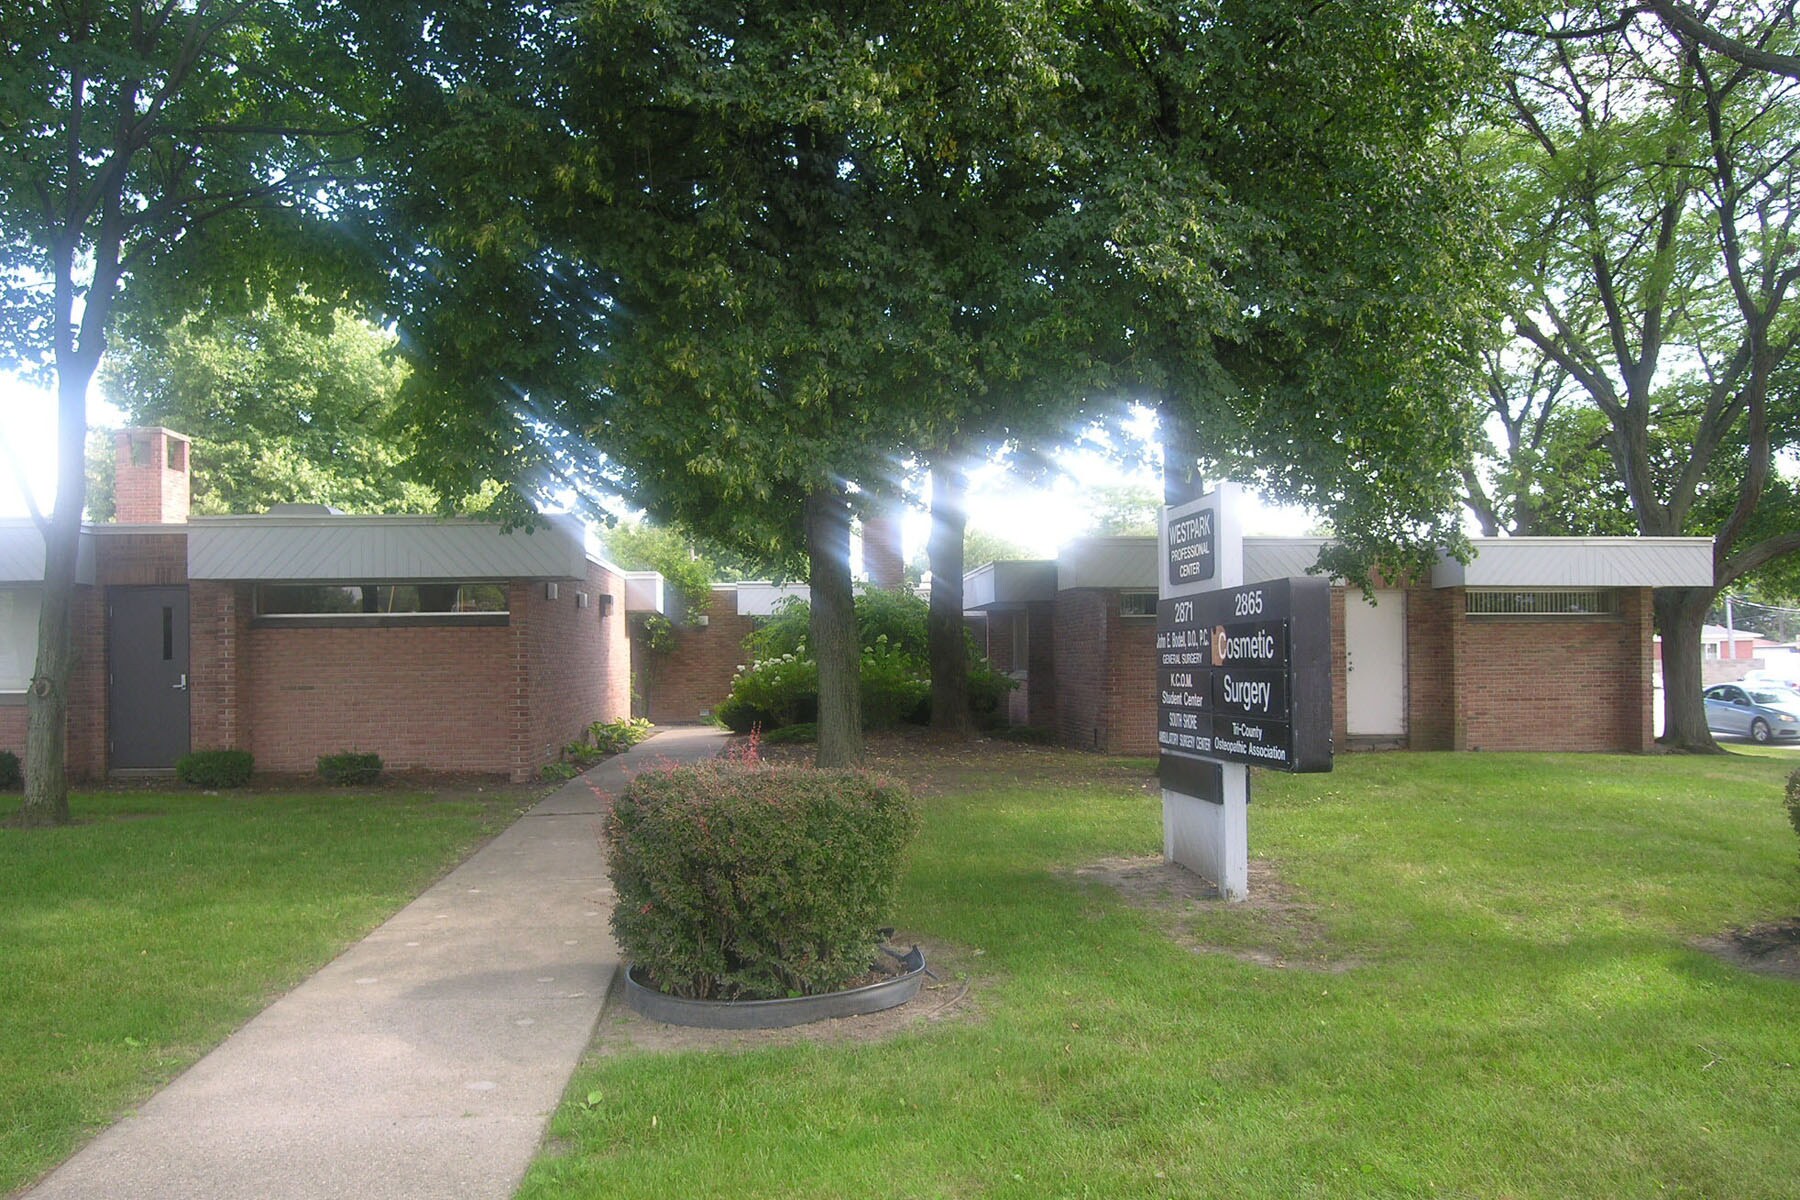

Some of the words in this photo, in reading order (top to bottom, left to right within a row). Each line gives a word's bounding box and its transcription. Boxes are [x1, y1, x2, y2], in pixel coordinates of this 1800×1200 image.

[1169, 514, 1211, 545] WESTPARK
[1171, 541, 1210, 562] PROFESSIONAL
[1180, 562, 1201, 577] CENTER
[1174, 601, 1193, 623] 2871
[1235, 590, 1263, 616] 2865
[1156, 632, 1166, 649] John
[1218, 629, 1274, 659] Cosmetic
[1162, 653, 1181, 665] GENERAL
[1181, 652, 1203, 665] SURGERY
[1161, 690, 1183, 705] Student
[1183, 692, 1203, 707] Center
[1223, 674, 1270, 712] Surgery
[1168, 712, 1182, 728] SOUTH
[1182, 713, 1198, 730] SHORE
[1232, 722, 1262, 741] Tri-County
[1179, 733, 1195, 749] SURGERY
[1195, 735, 1211, 751] CENTER
[1214, 736, 1247, 754] Osteopathic
[1248, 742, 1286, 760] Association
